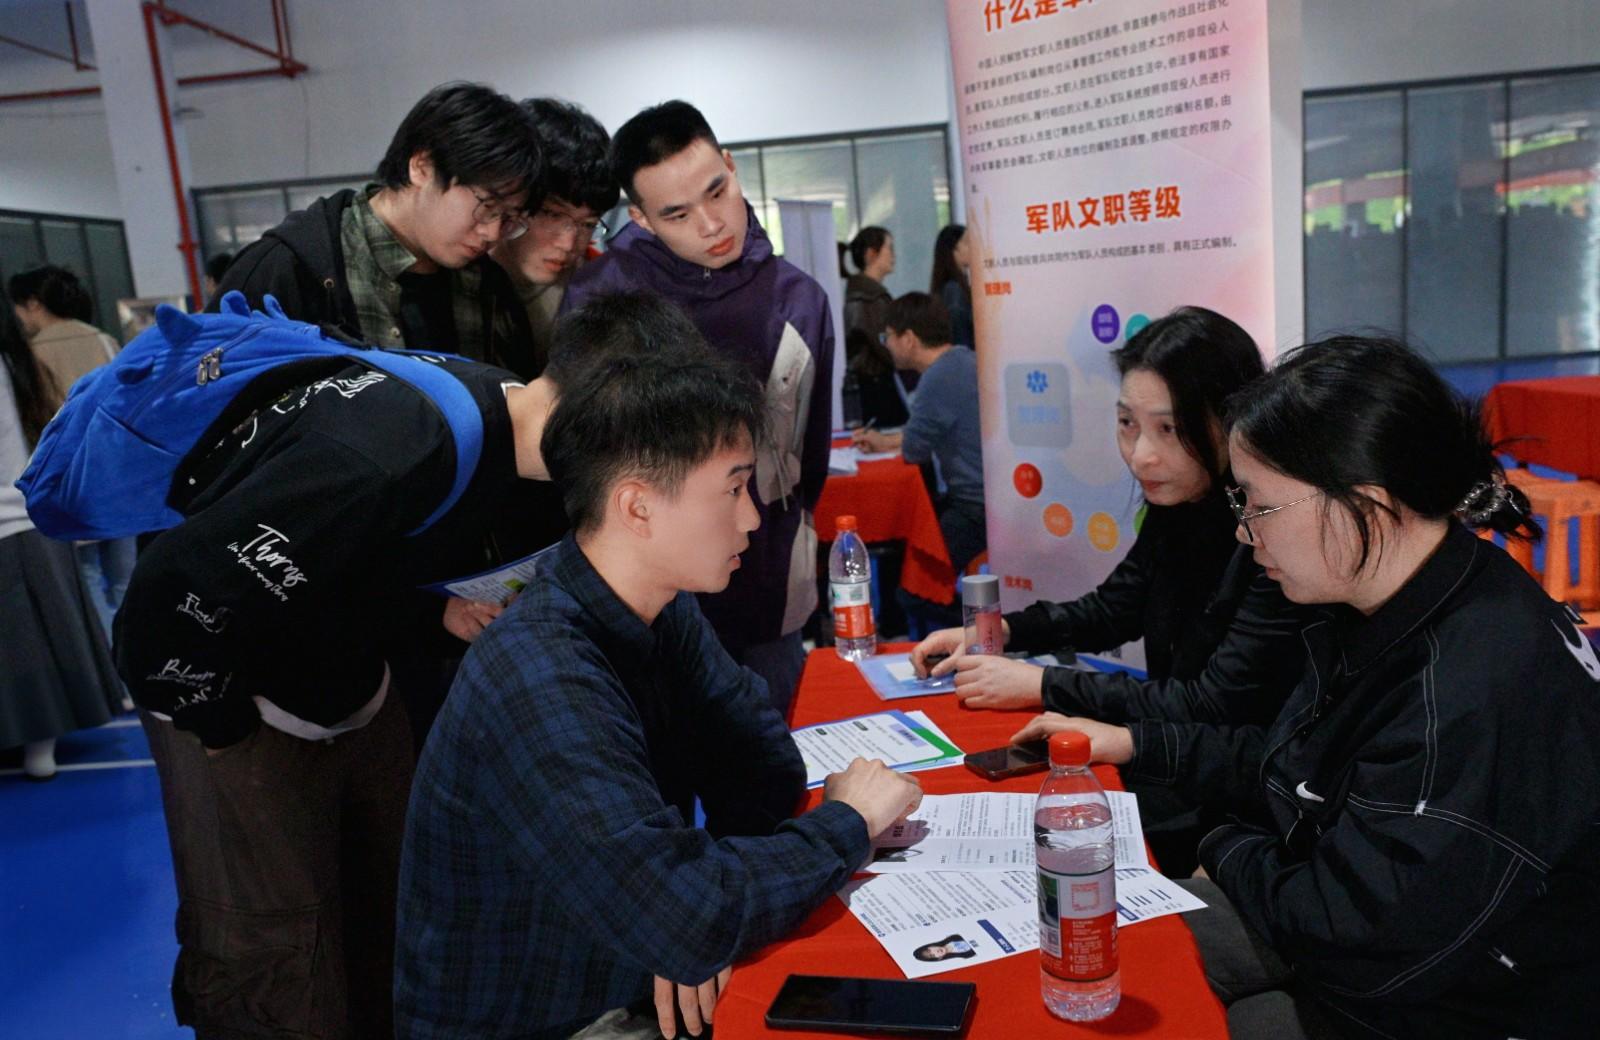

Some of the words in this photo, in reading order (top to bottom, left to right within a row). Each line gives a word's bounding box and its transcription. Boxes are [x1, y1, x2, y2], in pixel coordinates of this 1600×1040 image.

[984, 0, 1092, 32] 什么是
[1026, 186, 1181, 234] 军队文职等级
